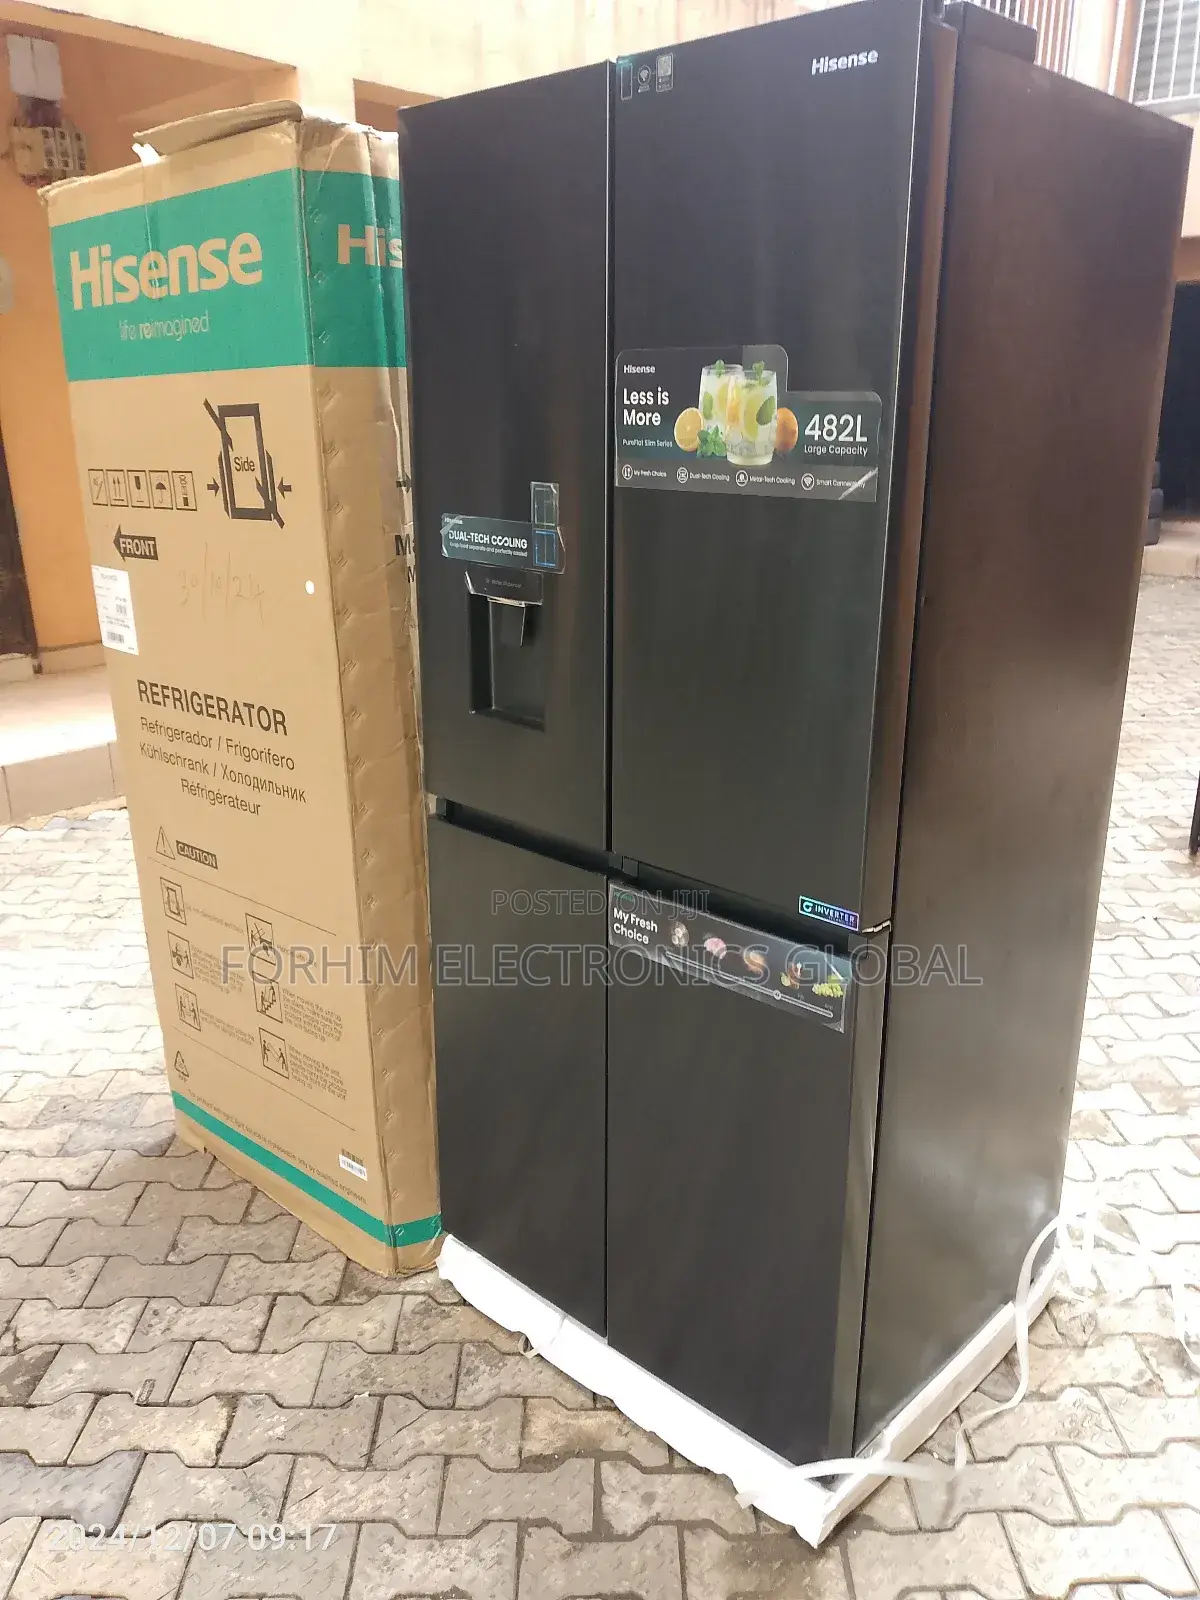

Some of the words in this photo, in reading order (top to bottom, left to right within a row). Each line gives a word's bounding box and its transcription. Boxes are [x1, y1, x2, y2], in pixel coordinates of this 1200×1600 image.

[811, 50, 879, 75] Hisense
[69, 232, 263, 311] Hisense
[139, 310, 209, 342] reimagined
[623, 364, 656, 374] Hisense
[623, 388, 654, 406] Less
[657, 386, 669, 406] is
[623, 408, 661, 427] More
[804, 413, 868, 443] 482L
[644, 439, 656, 447] Slim
[656, 440, 673, 448] Series
[804, 444, 827, 456] Large
[828, 445, 868, 458] Capacity
[233, 456, 256, 473] Side
[651, 470, 667, 478] Choice
[689, 472, 712, 480] Dual-Tech
[711, 474, 730, 482] Cooling
[749, 475, 775, 483] Metal-Tech
[775, 476, 796, 485] Cooling
[119, 537, 156, 558] FRONT
[448, 529, 490, 545] DUAL-TECH
[136, 679, 288, 736] REFRIGERATOR
[140, 716, 213, 749] Refrigerador
[217, 735, 221, 751] /
[226, 738, 295, 771] Frigorifero
[139, 741, 210, 775] Kühlschrank
[213, 762, 217, 777] /
[220, 763, 307, 803] Холодильник
[180, 778, 261, 816] Réfrigérateur
[177, 842, 217, 868] CAUTION
[613, 907, 629, 924] My
[630, 913, 657, 933] Fresh
[815, 904, 855, 923] INVERTER
[613, 923, 649, 944] Choice
